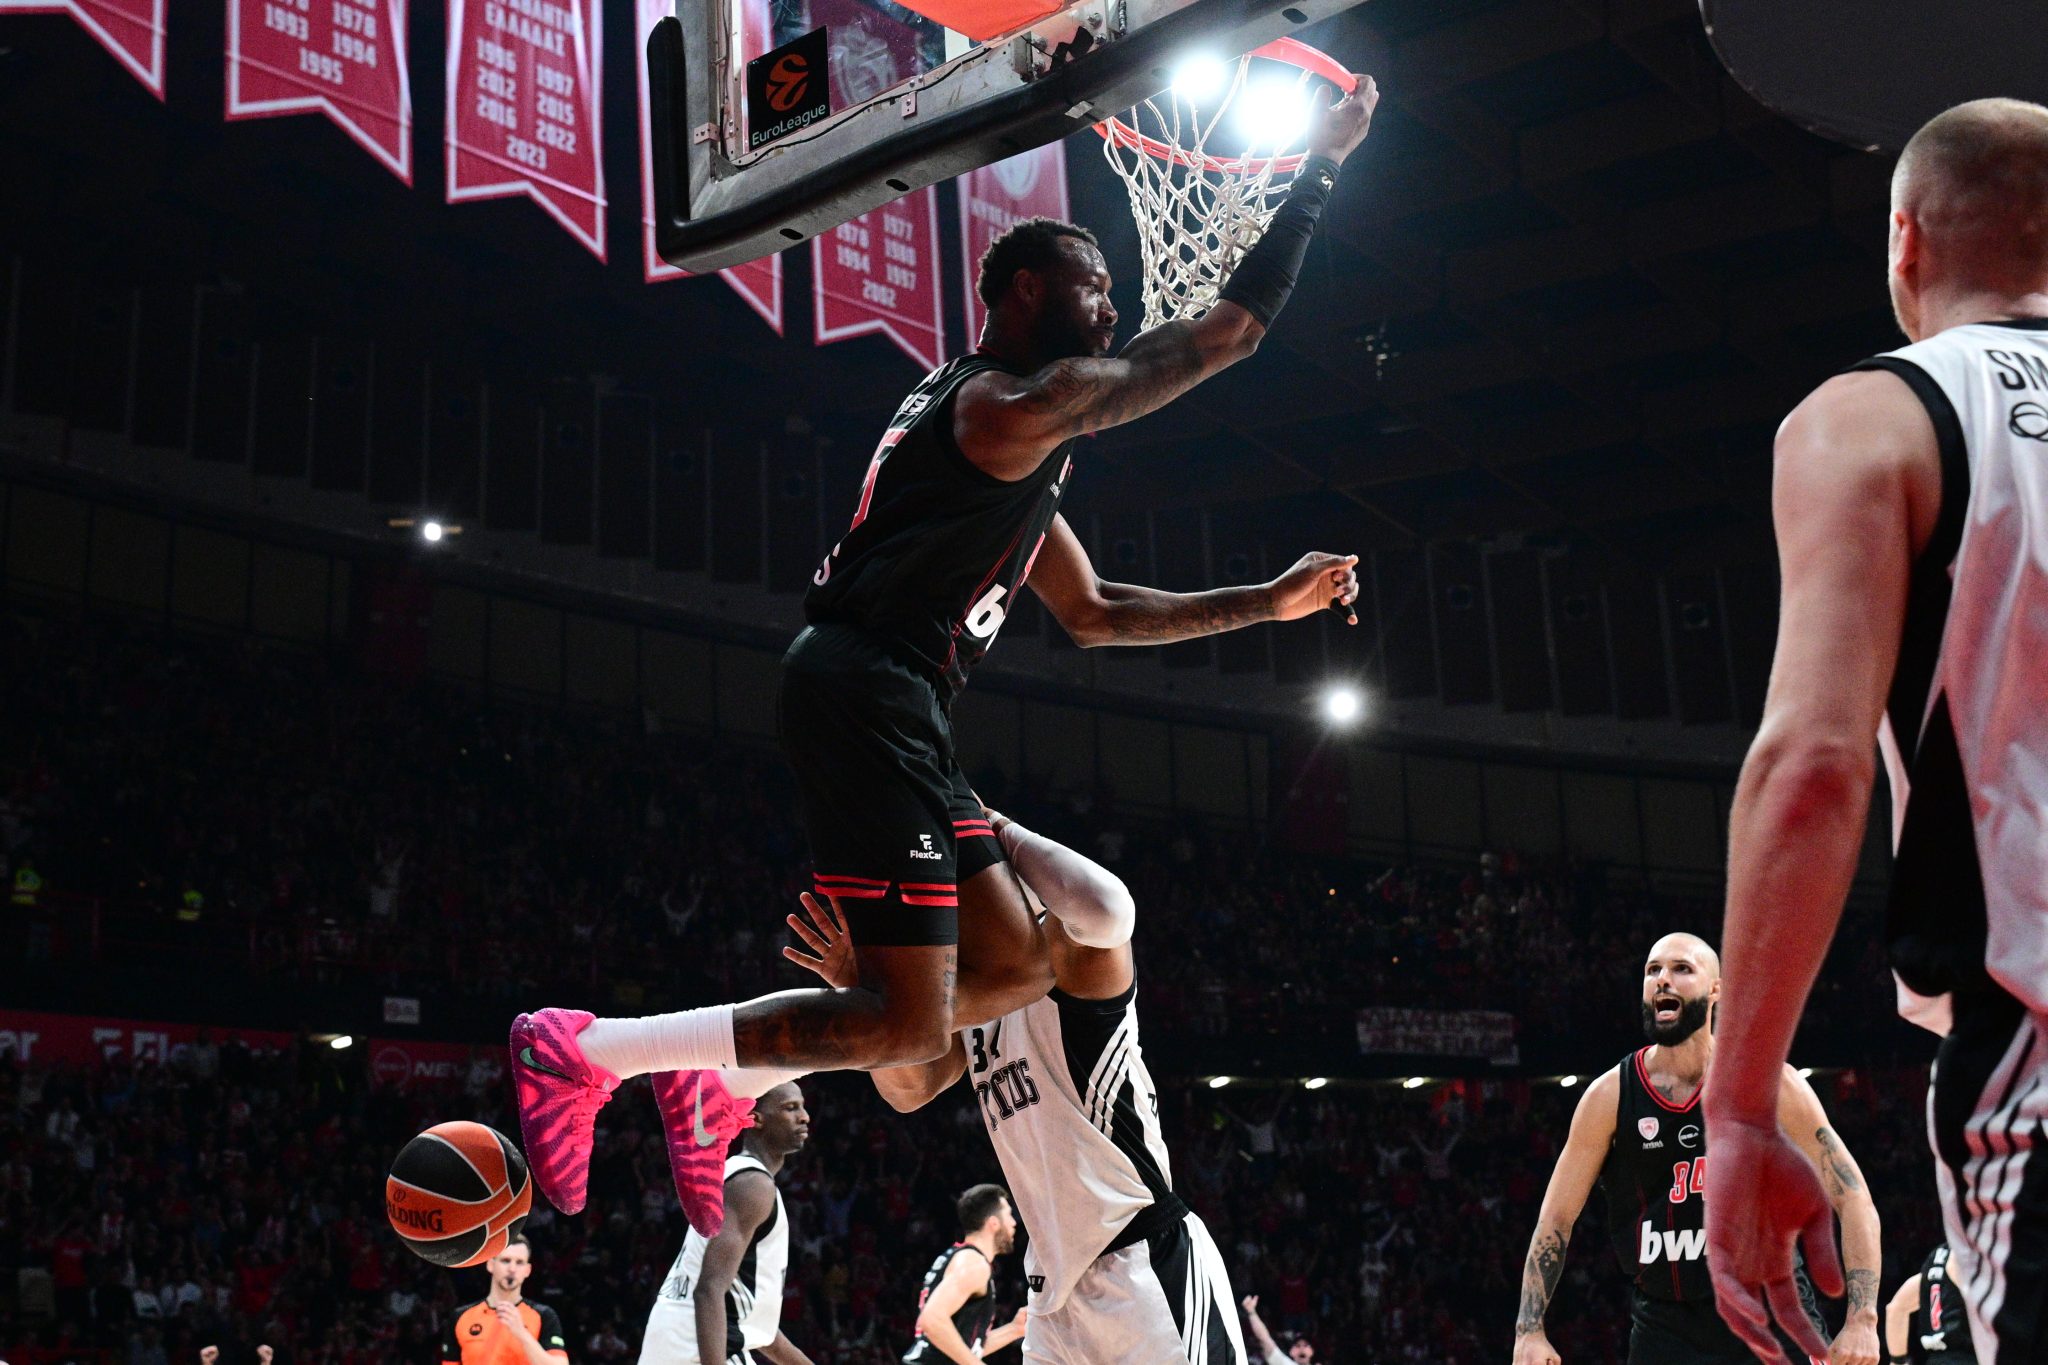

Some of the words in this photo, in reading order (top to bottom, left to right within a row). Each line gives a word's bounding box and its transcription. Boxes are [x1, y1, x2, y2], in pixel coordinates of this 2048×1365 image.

[265, 3, 309, 41] 1993
[332, 2, 377, 39] 1978
[300, 48, 343, 84] 1995
[332, 31, 377, 68] 1994
[477, 65, 516, 100] 2012
[477, 94, 517, 129] 2016
[537, 91, 575, 126] 2015
[752, 104, 827, 146] EuroLeague
[506, 134, 547, 169] 2023
[536, 119, 577, 154] 2022
[910, 849, 942, 860] FlexCar
[1639, 1220, 1708, 1264] bw
